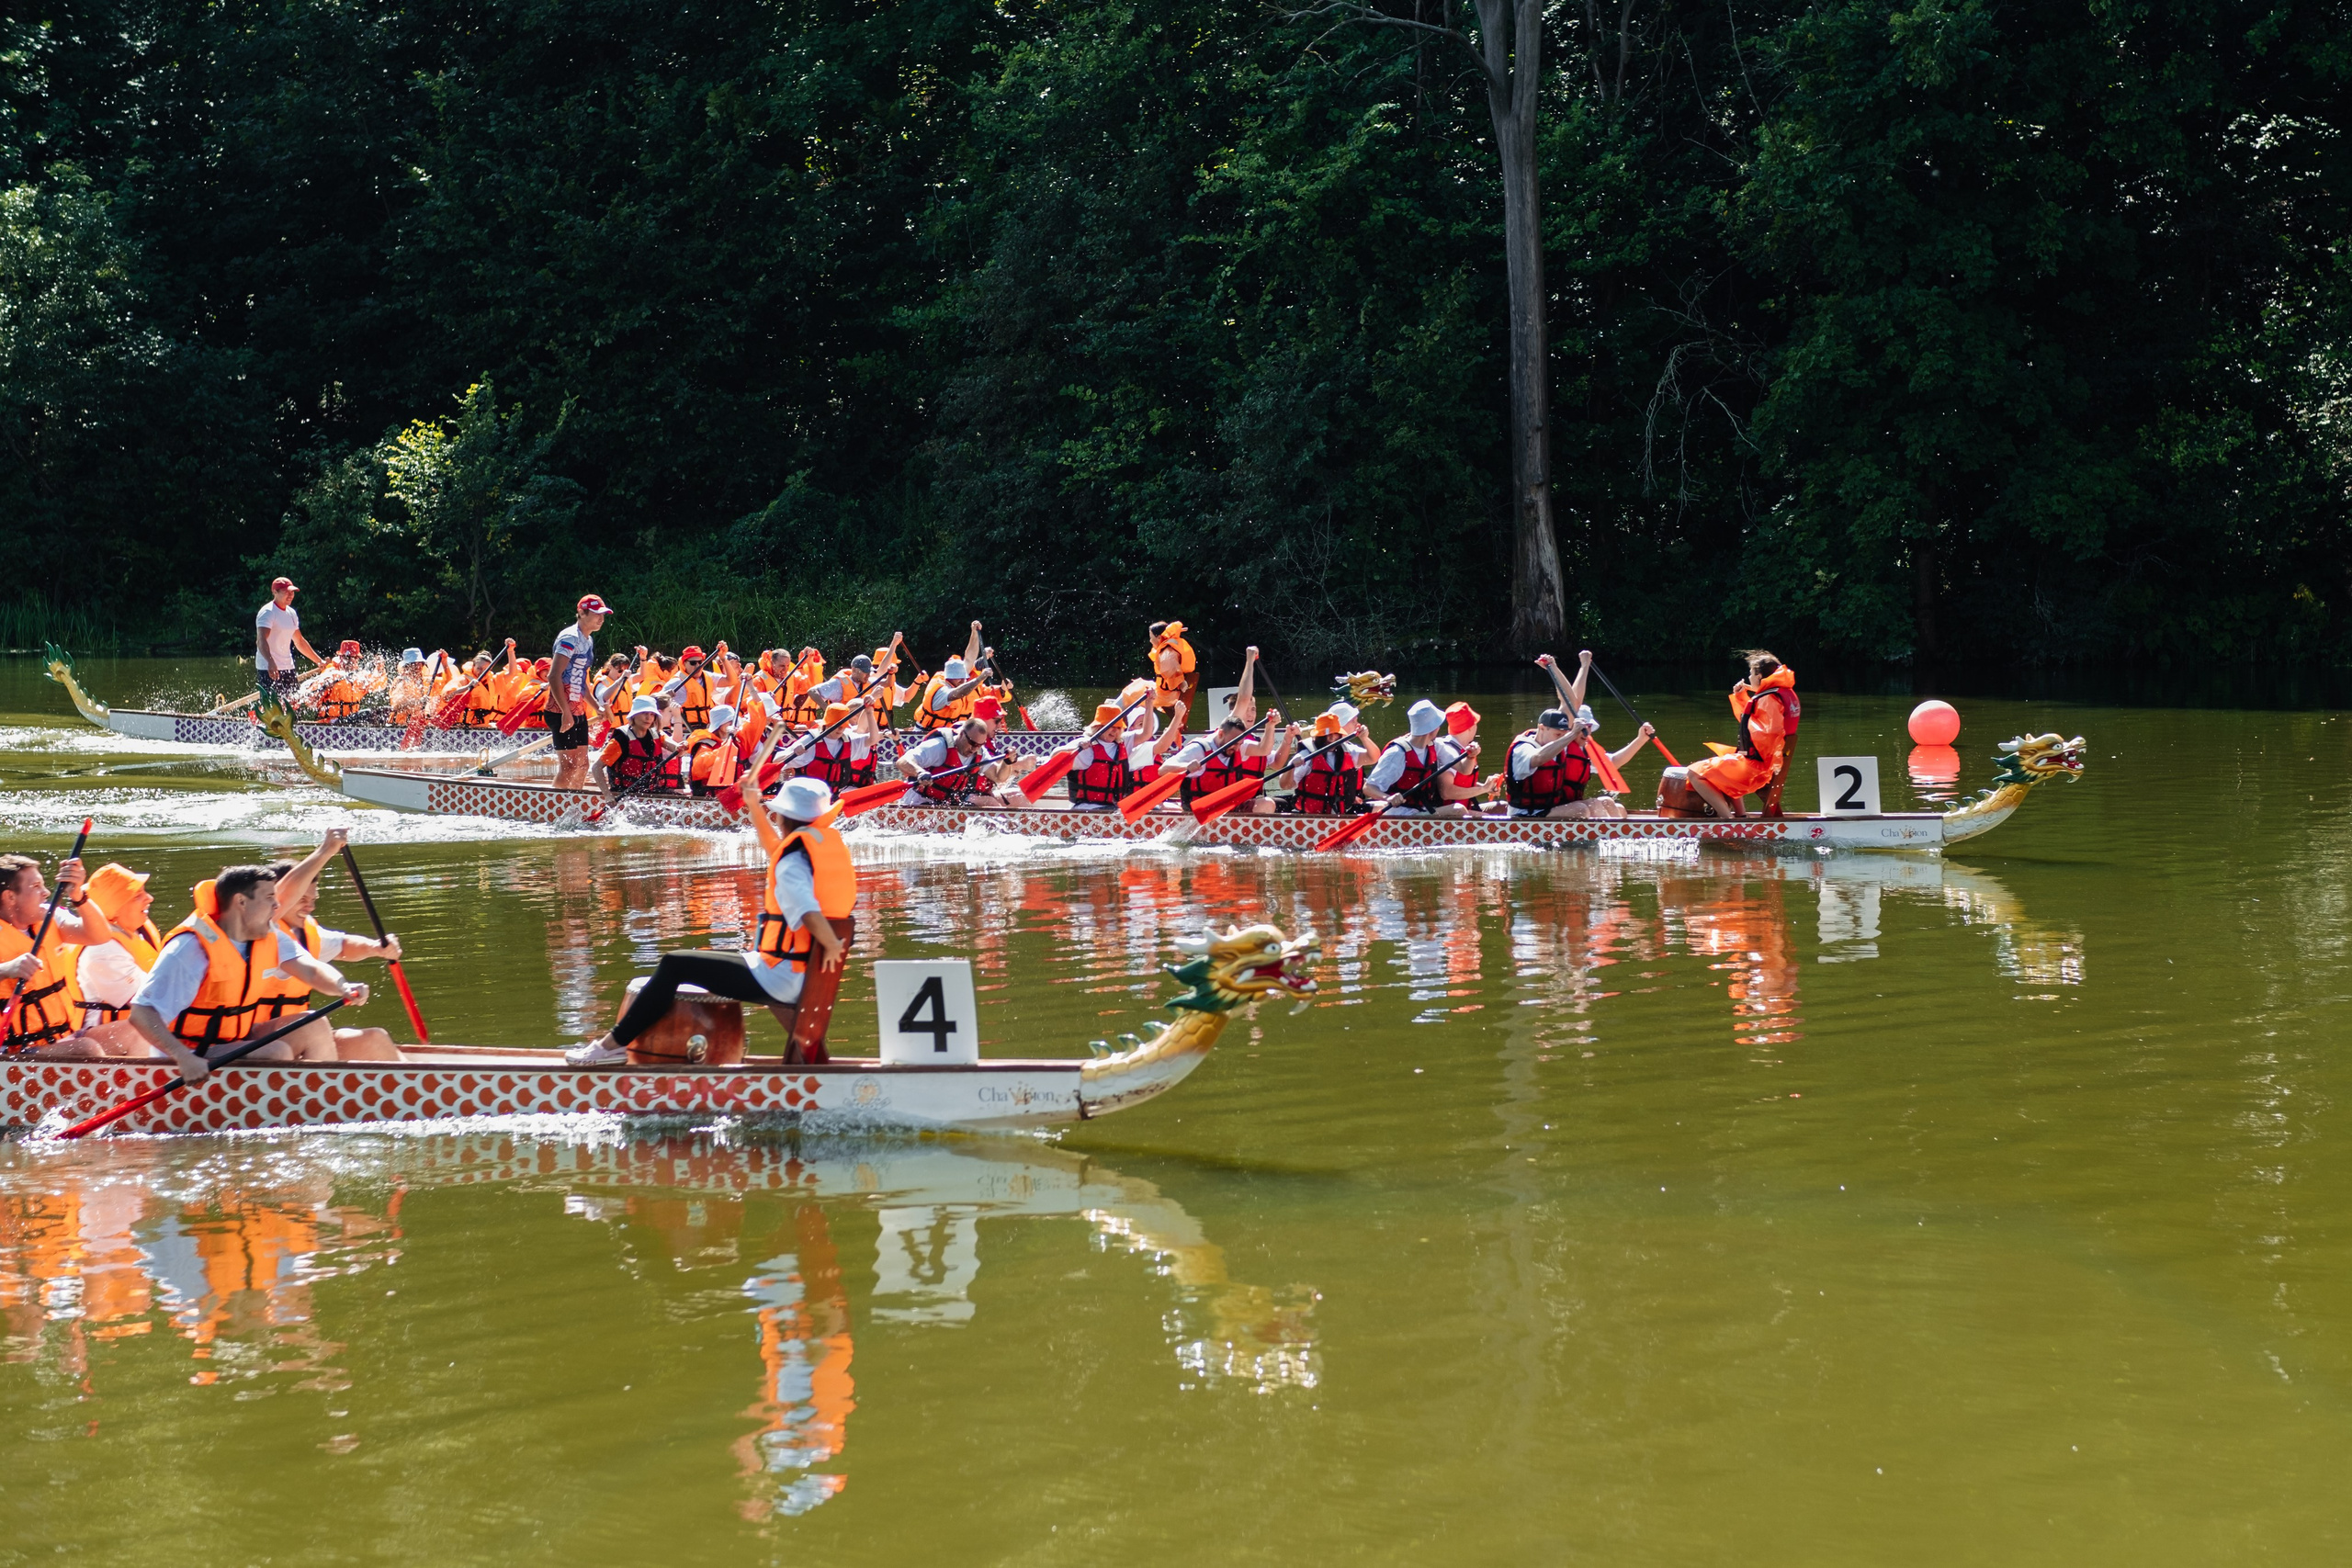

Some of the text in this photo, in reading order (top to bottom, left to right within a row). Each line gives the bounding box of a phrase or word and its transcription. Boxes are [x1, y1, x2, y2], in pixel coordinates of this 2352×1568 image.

[569, 657, 588, 702] RUSSIA
[1834, 765, 1866, 809] 2
[898, 976, 957, 1053] 4
